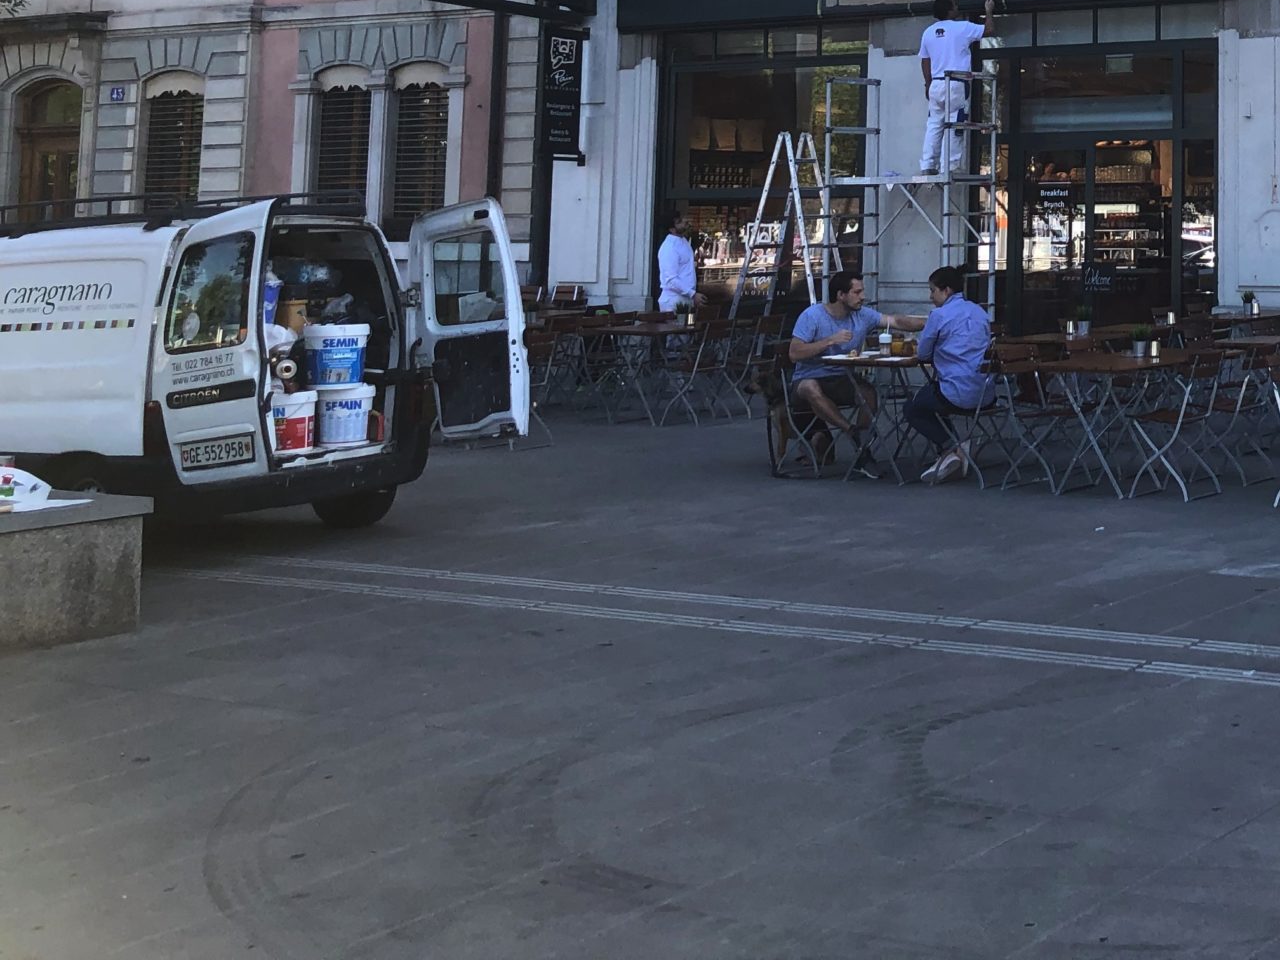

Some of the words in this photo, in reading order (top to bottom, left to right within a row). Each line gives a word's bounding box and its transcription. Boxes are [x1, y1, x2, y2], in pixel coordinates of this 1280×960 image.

[1040, 189, 1069, 197] Breakfast
[4, 282, 113, 315] caragnano
[322, 338, 359, 348] SEMIN
[184, 359, 198, 370] 022
[225, 352, 234, 362] 77
